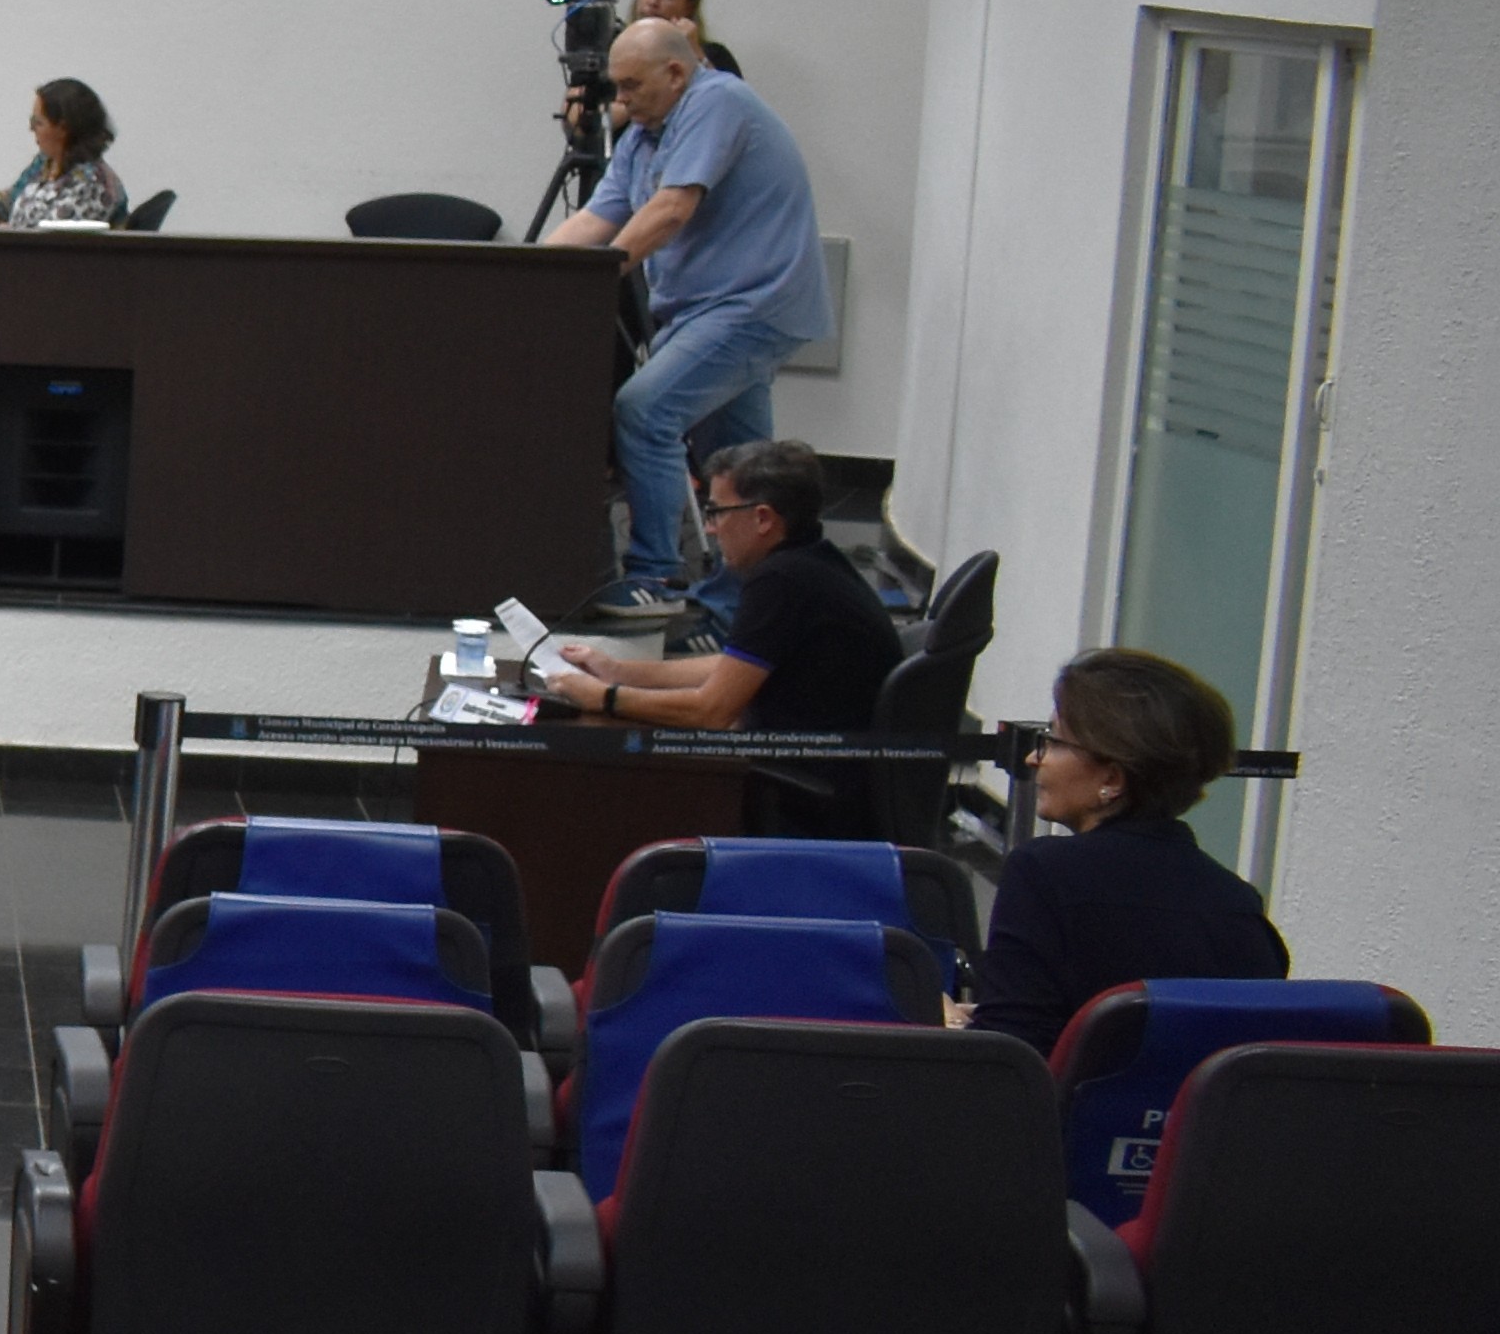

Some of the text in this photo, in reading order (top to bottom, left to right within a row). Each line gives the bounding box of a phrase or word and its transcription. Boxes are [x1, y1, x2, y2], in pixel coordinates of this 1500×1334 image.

[302, 717, 355, 732] Municipal
[358, 720, 370, 730] de
[257, 730, 294, 741] Acesso
[297, 731, 336, 743] restrito
[339, 734, 377, 746] apenas
[380, 735, 404, 746] para
[652, 730, 694, 741] Câmara
[697, 731, 751, 744] Municipal
[753, 732, 766, 743] de
[652, 743, 690, 755] Acesso
[693, 744, 732, 755] restrito
[735, 746, 772, 758] apenas
[775, 747, 801, 758] para
